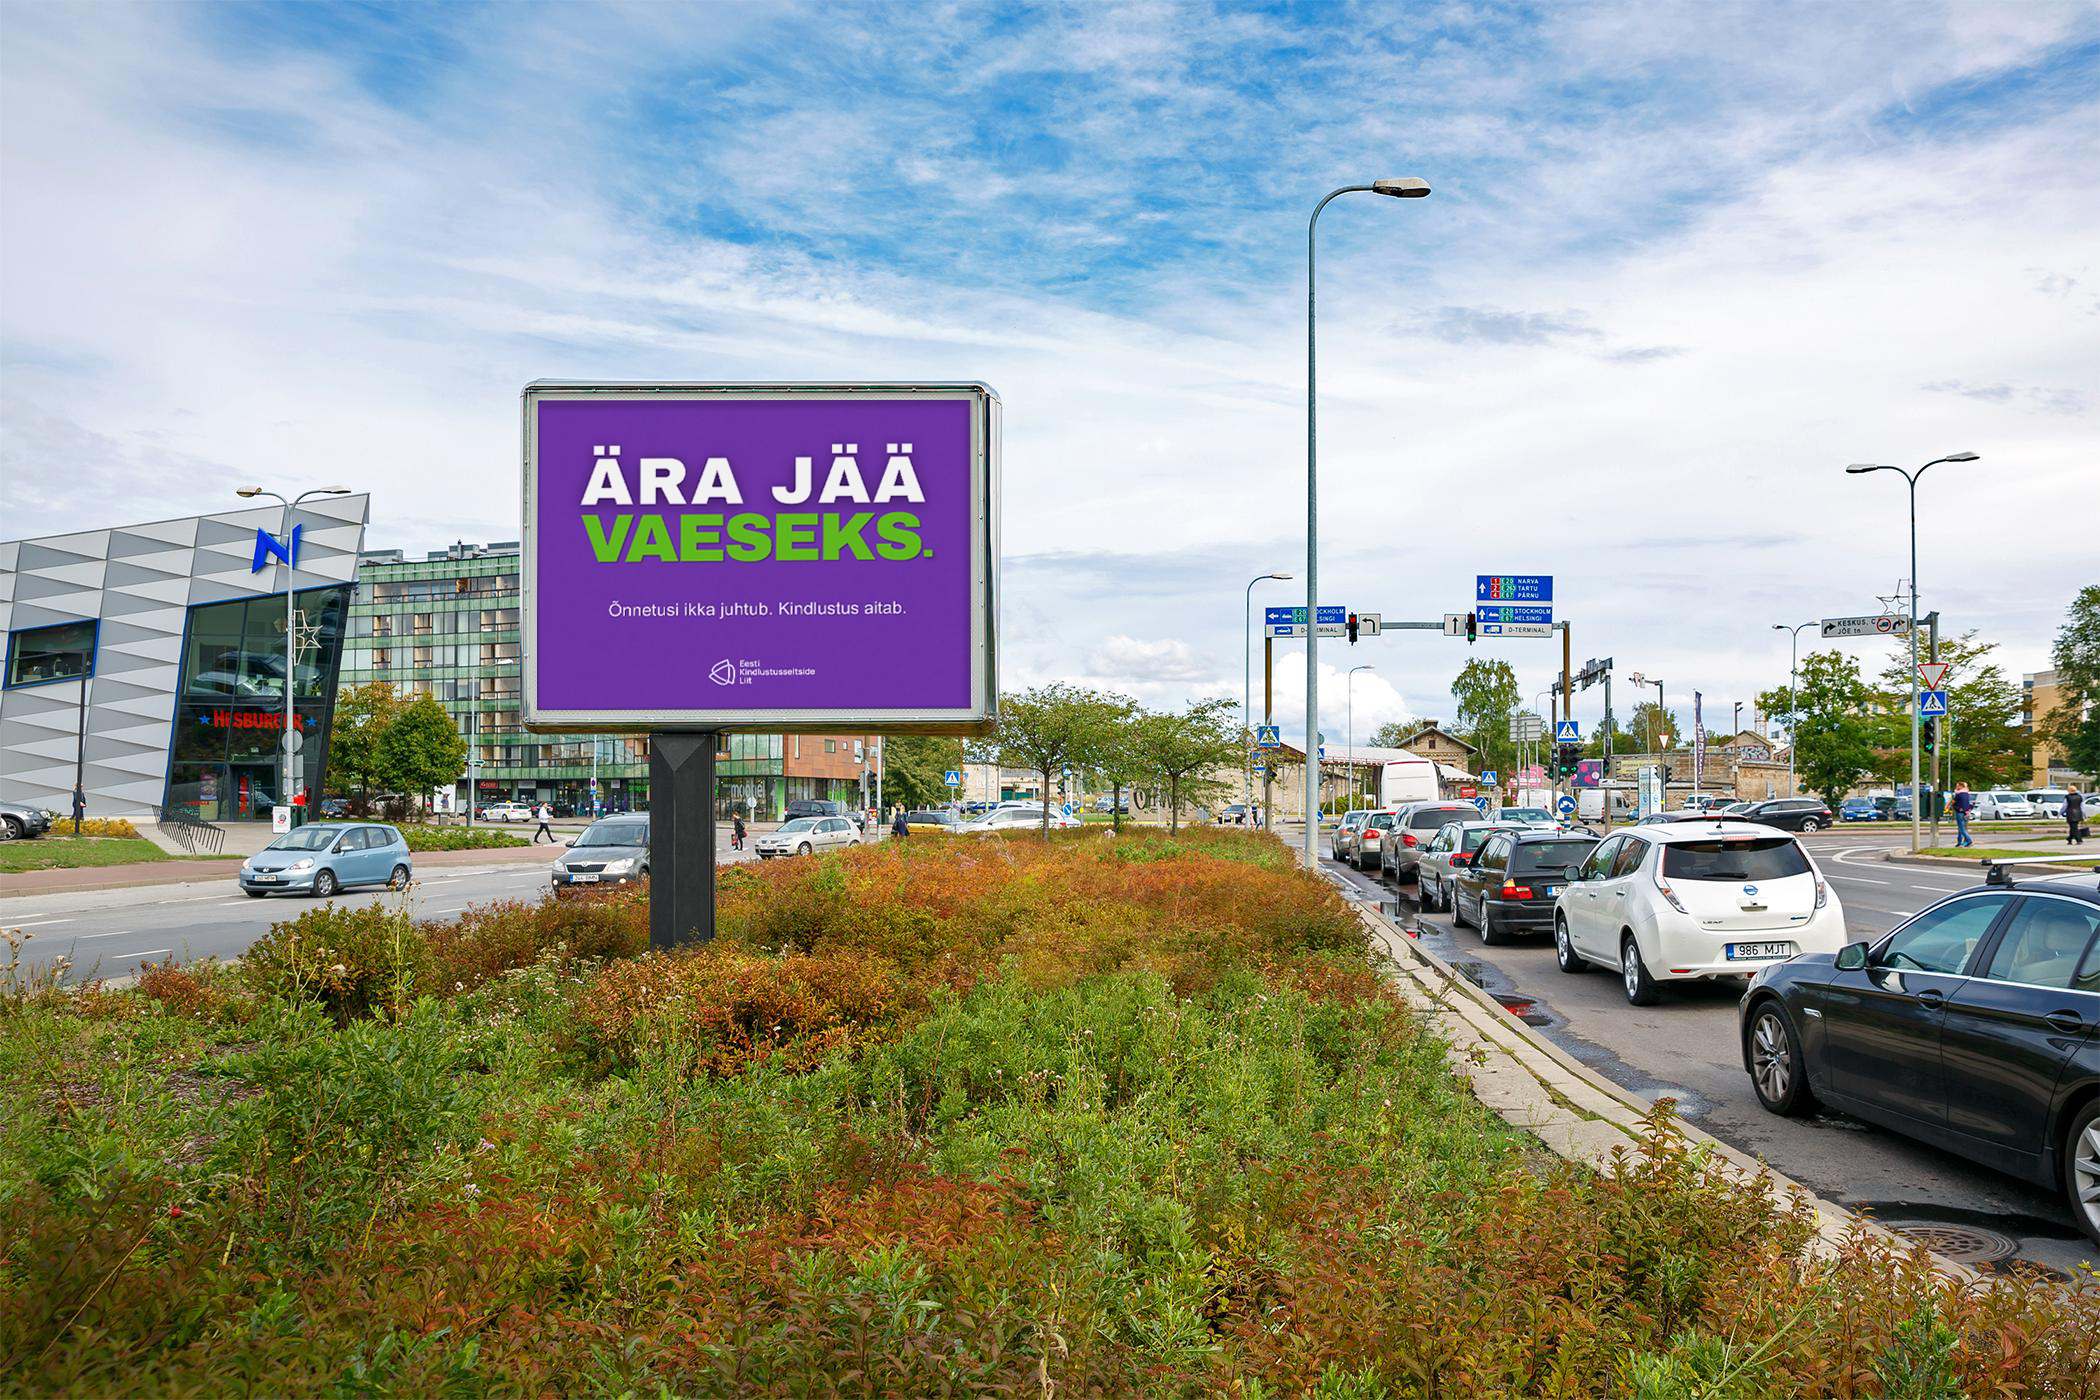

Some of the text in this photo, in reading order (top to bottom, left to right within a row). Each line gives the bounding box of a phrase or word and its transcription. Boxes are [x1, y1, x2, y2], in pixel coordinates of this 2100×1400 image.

[580, 443, 926, 506] ÄRA JÄÄ
[581, 511, 933, 563] VAESEKS.
[608, 600, 907, 620] Õnnetusi ikka juhtub. Kindlustus aitab.
[739, 659, 760, 668] Eesti
[739, 668, 816, 676] Kindlustusseltside
[739, 676, 752, 685] Liit
[1738, 943, 1786, 956] 986 MJT
